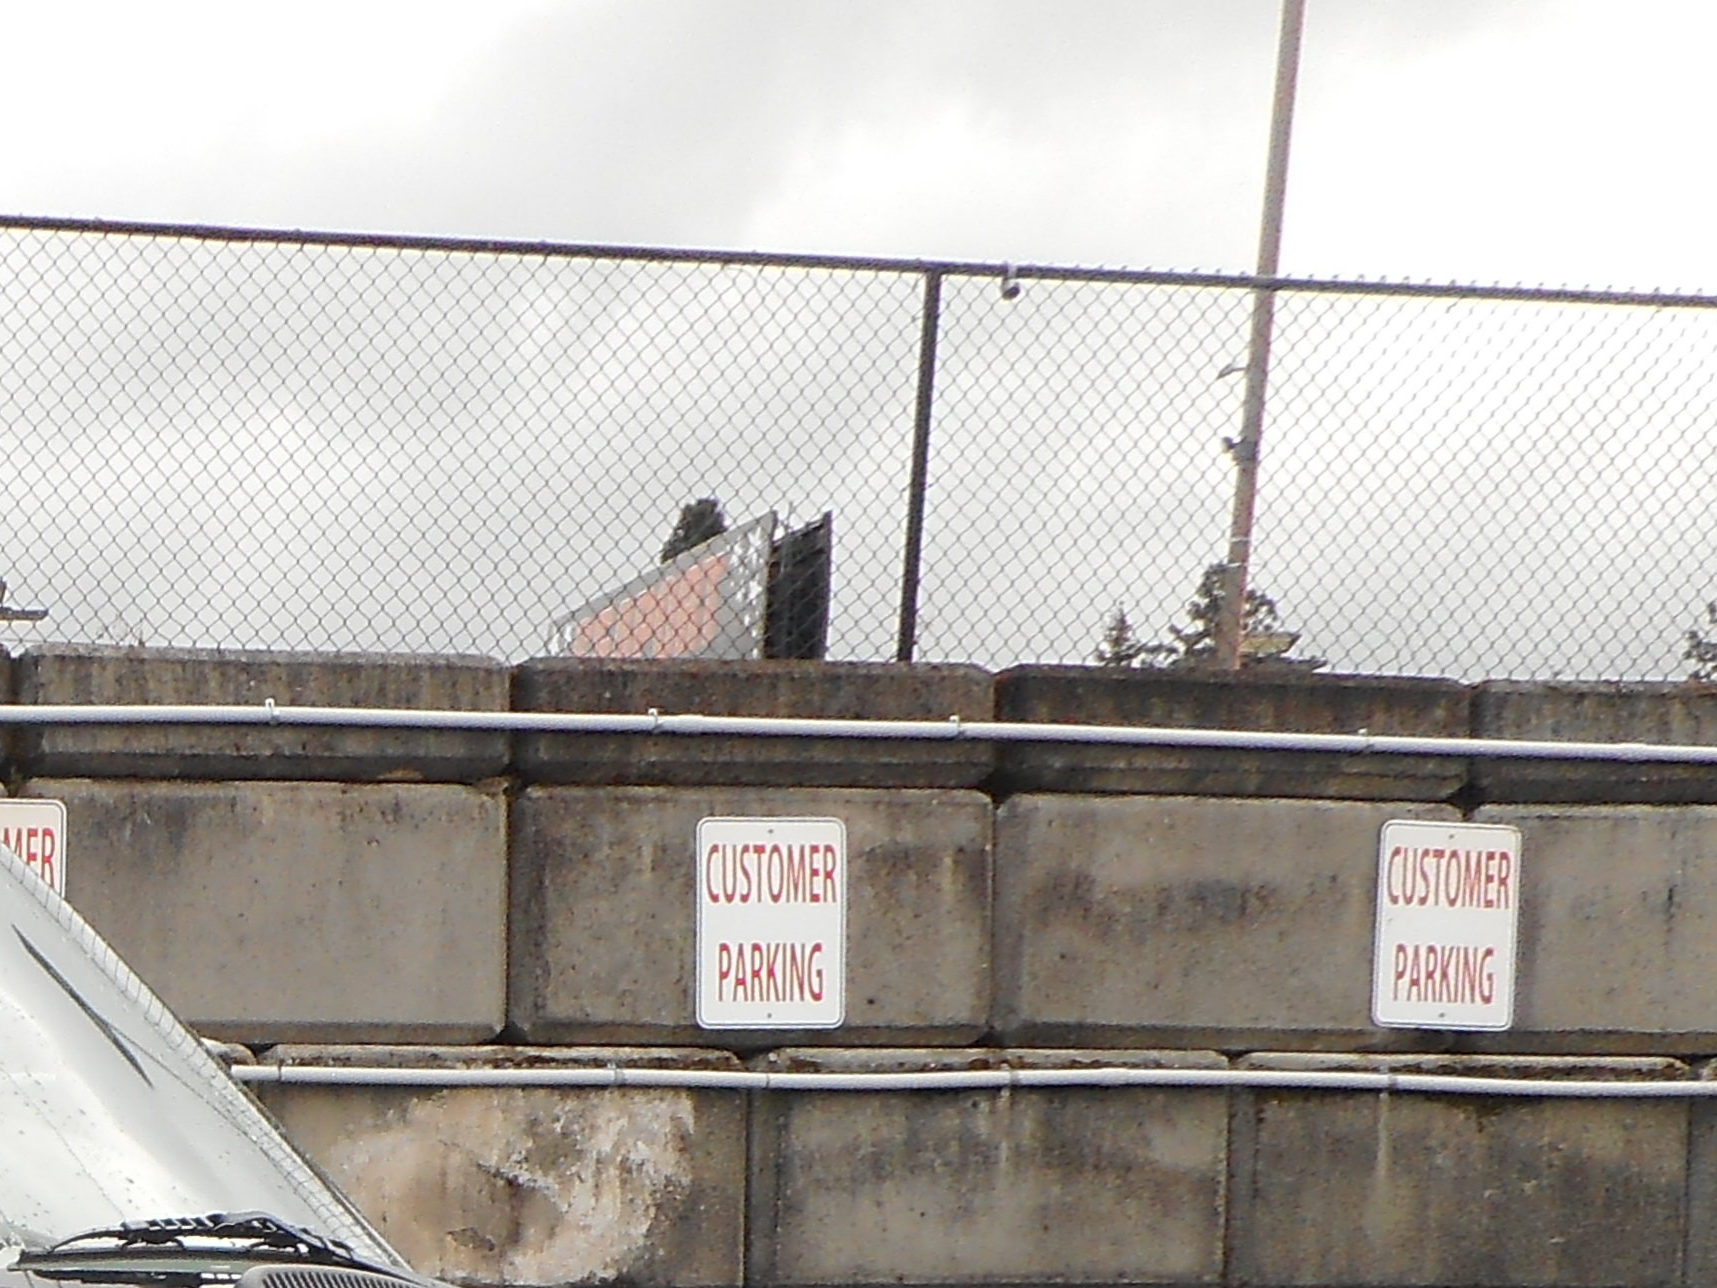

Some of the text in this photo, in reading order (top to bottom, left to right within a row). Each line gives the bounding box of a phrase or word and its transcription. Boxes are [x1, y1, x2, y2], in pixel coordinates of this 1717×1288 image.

[705, 843, 838, 903] CUSTOMER
[1386, 846, 1512, 910] CUSTOMER
[718, 942, 824, 1002] PARKING
[1392, 943, 1495, 1005] PARKING
